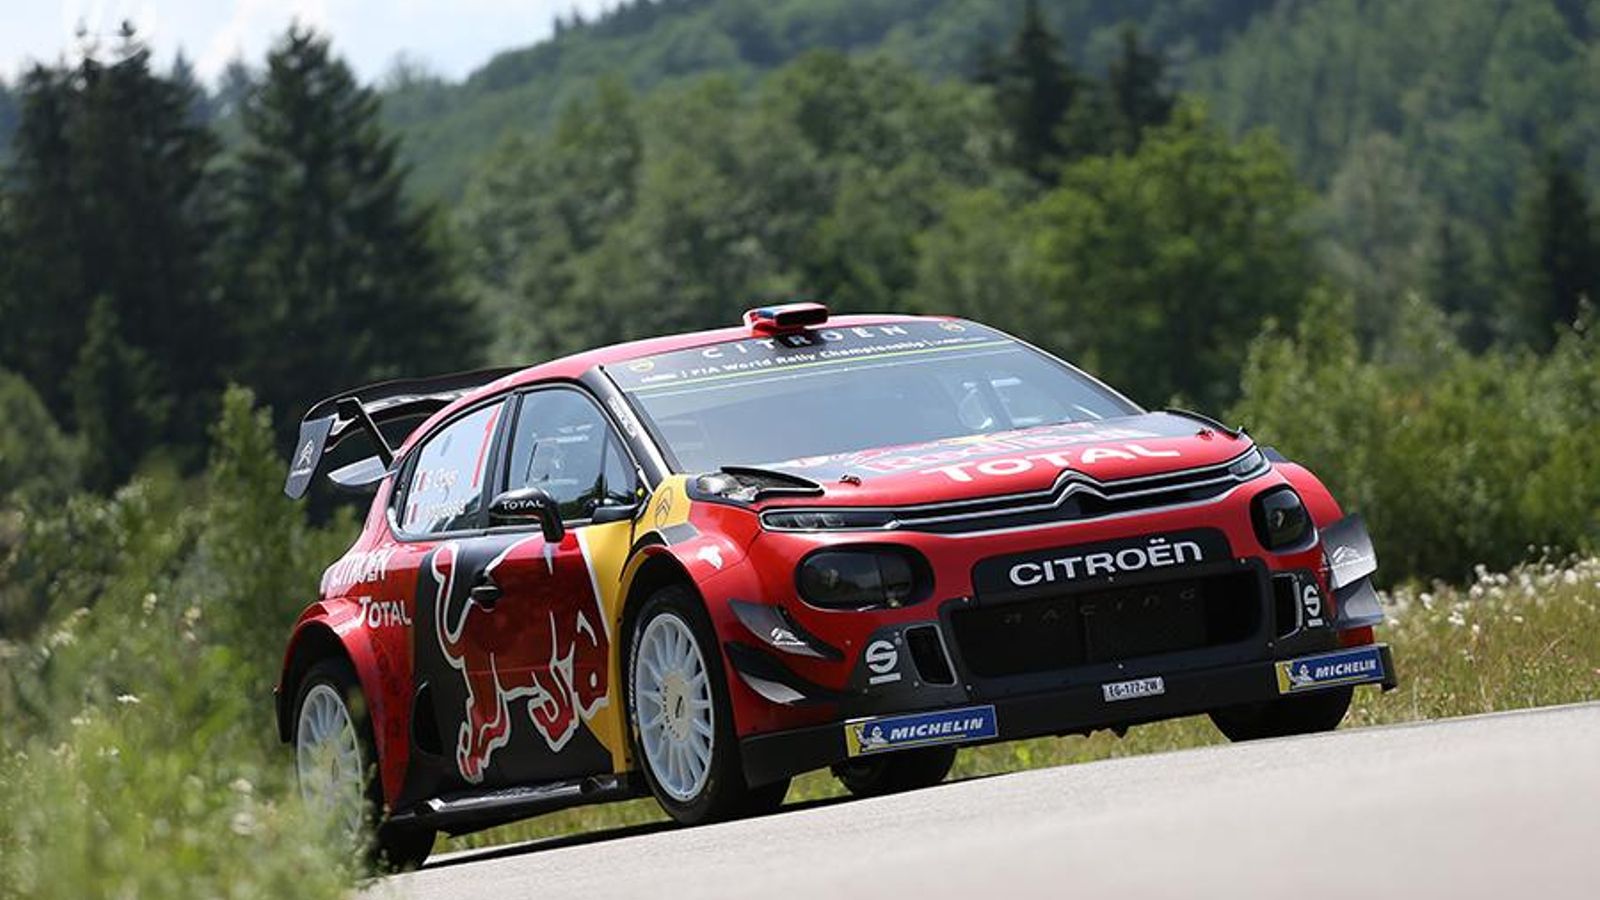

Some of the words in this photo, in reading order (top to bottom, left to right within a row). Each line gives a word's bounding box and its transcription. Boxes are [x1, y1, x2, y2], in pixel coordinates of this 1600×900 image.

[721, 357, 772, 370] World
[920, 444, 1180, 482] TOTAL
[502, 499, 545, 510] TOTAL
[358, 595, 412, 629] TOTAL
[1315, 659, 1377, 679] MICHELIN
[889, 717, 984, 741] MICHELIN
